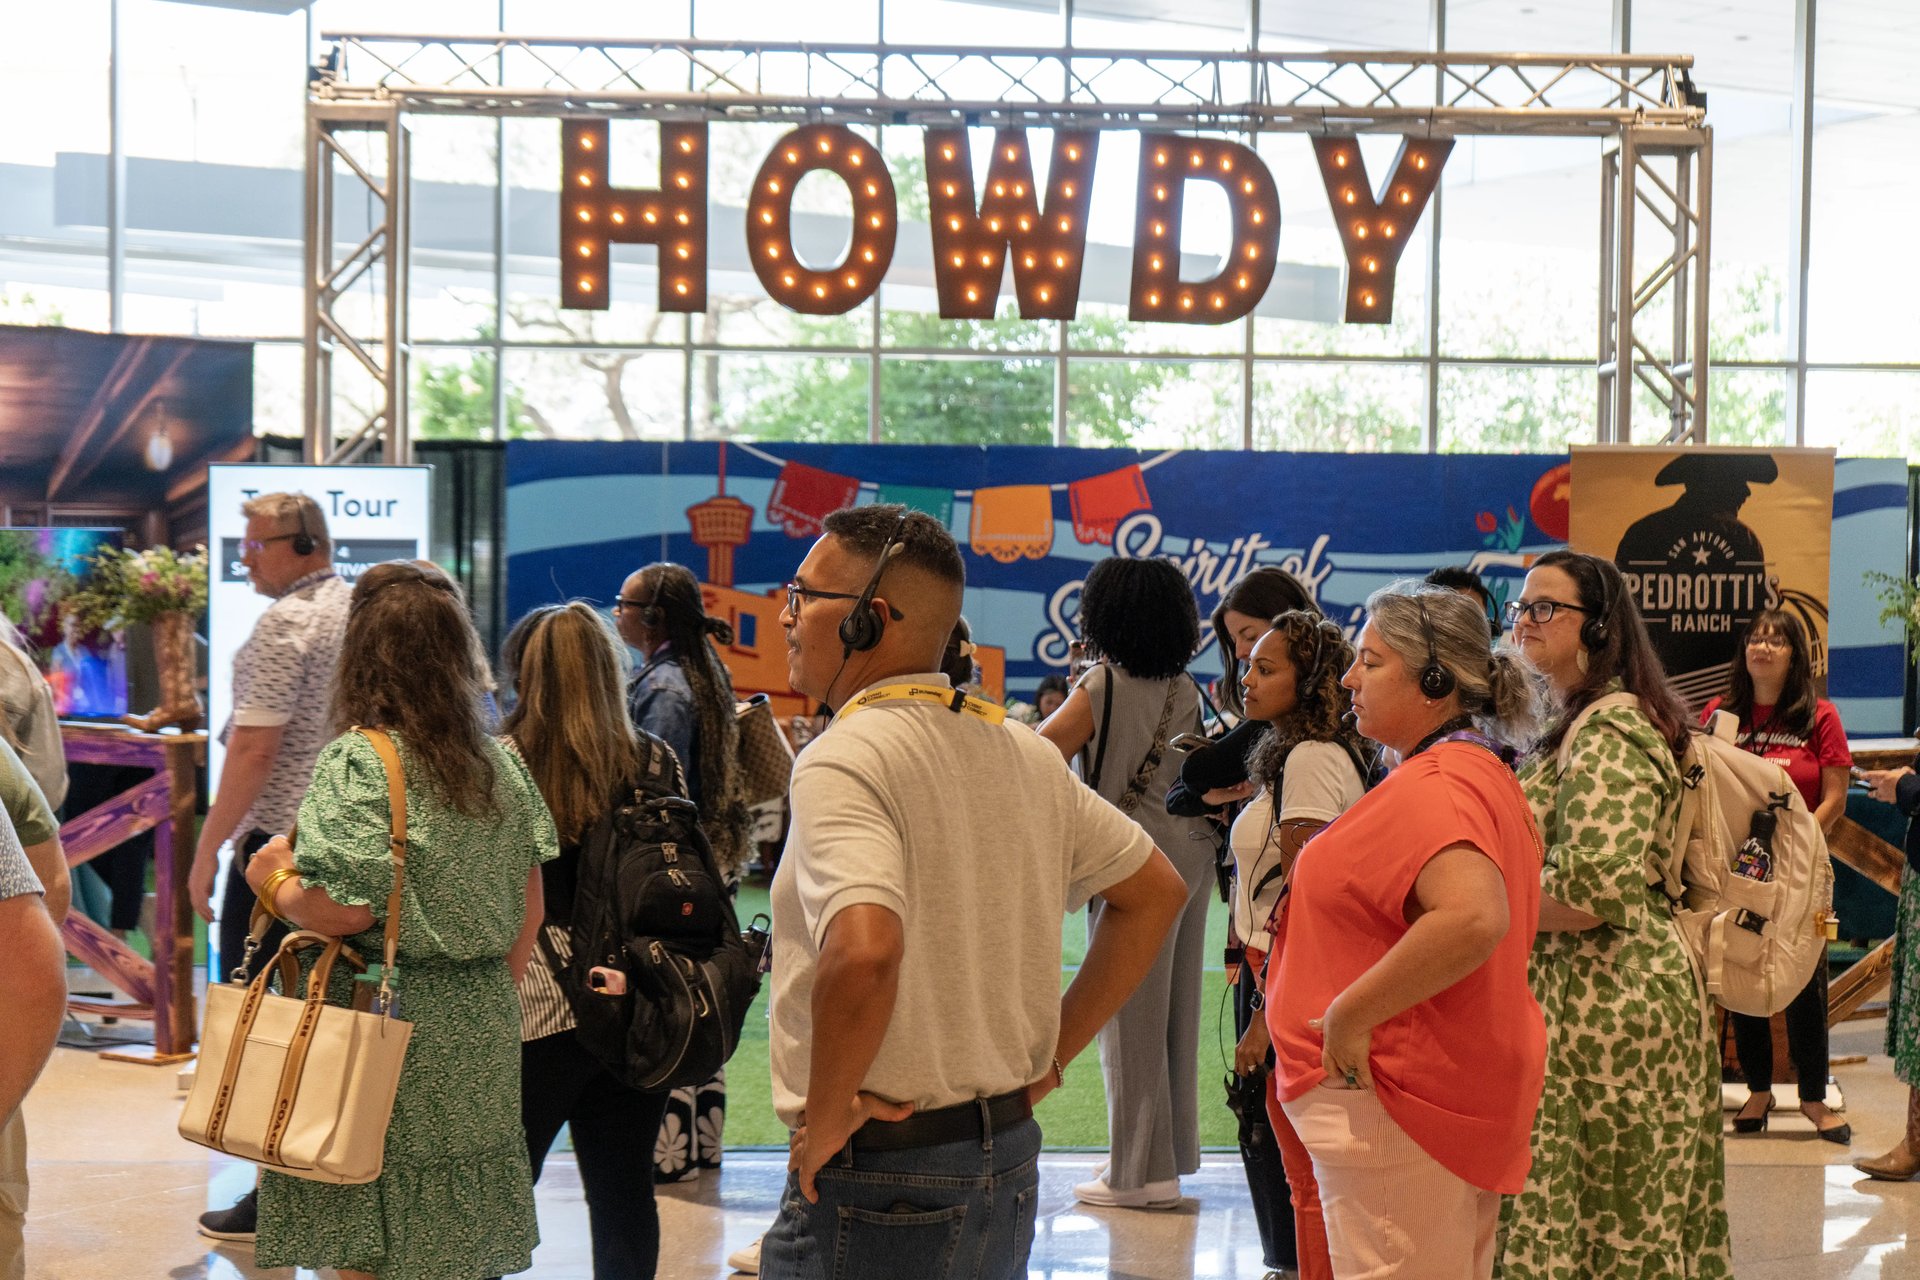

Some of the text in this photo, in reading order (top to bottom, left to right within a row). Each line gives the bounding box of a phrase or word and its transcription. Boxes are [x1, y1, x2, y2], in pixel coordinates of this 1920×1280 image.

[561, 118, 1456, 325] HOWDY
[327, 490, 398, 517] Tour
[1668, 530, 1735, 560] SAN ANTONIO
[1627, 573, 1780, 611] PEDROTTI'S
[1671, 614, 1731, 633] RANCH
[301, 980, 321, 1038] COACH
[211, 1084, 230, 1143] COACH
[268, 1097, 289, 1158] COACH
